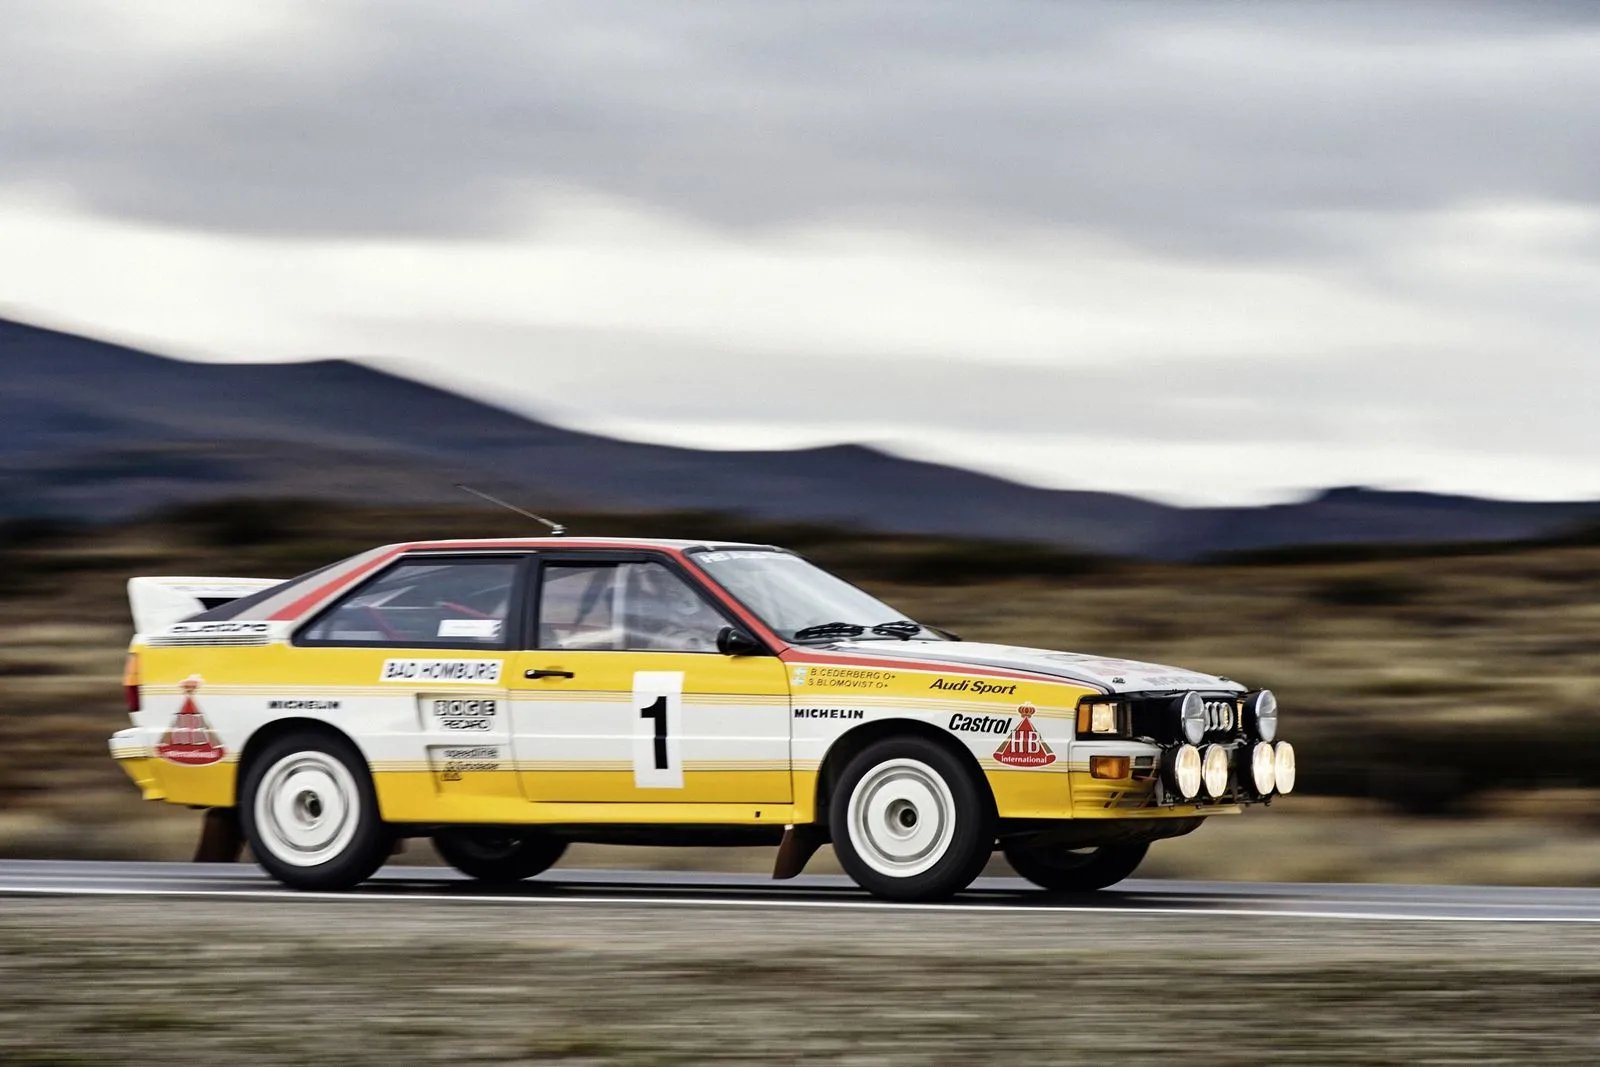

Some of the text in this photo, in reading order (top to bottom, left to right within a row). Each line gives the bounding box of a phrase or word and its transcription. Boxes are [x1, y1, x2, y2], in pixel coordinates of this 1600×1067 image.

[386, 662, 499, 680] BAD HOMBURG
[929, 678, 1017, 694] Audi Sport
[268, 700, 340, 710] MICHELIN
[794, 708, 864, 719] MICHELIN
[948, 713, 1013, 735] Castrol
[640, 696, 668, 770] 1
[1010, 729, 1042, 754] HB
[1001, 755, 1048, 764] international
